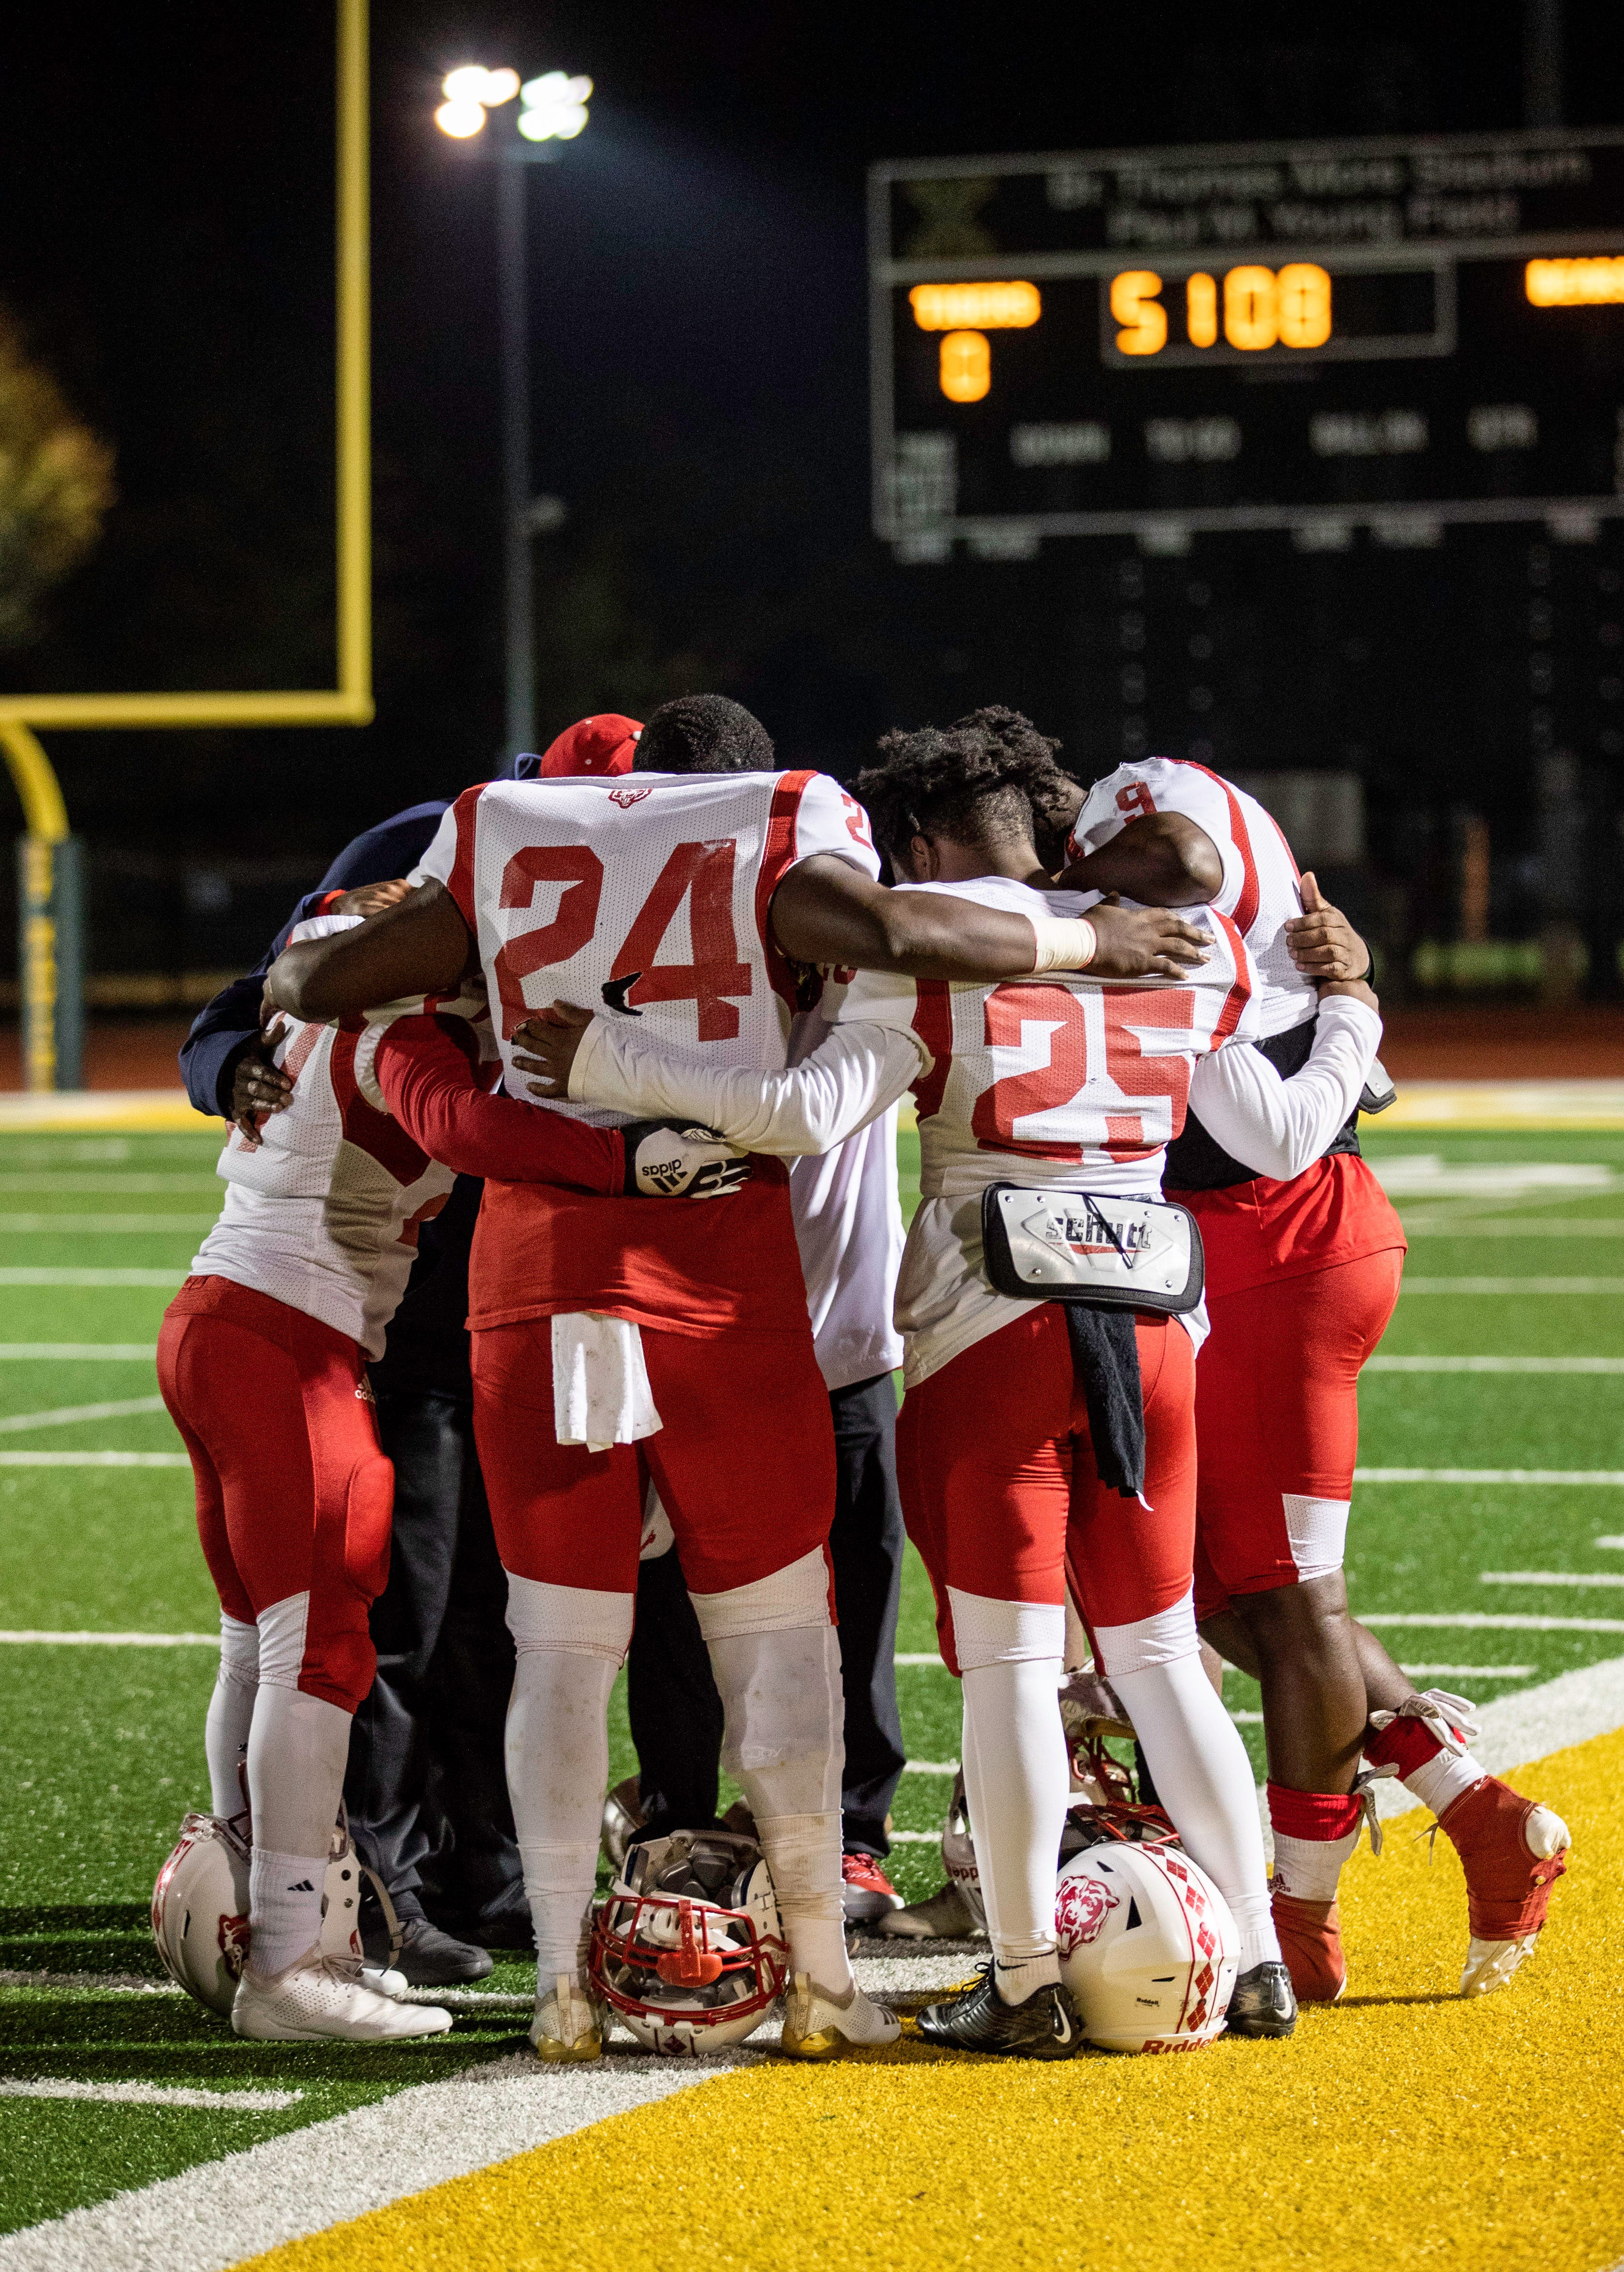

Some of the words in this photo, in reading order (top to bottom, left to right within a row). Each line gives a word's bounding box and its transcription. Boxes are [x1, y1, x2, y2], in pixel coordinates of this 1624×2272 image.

[494, 838, 752, 1042] 24
[972, 982, 1195, 1165] 25
[641, 1159, 682, 1177] adidas
[1136, 1997, 1159, 2005] Riddell
